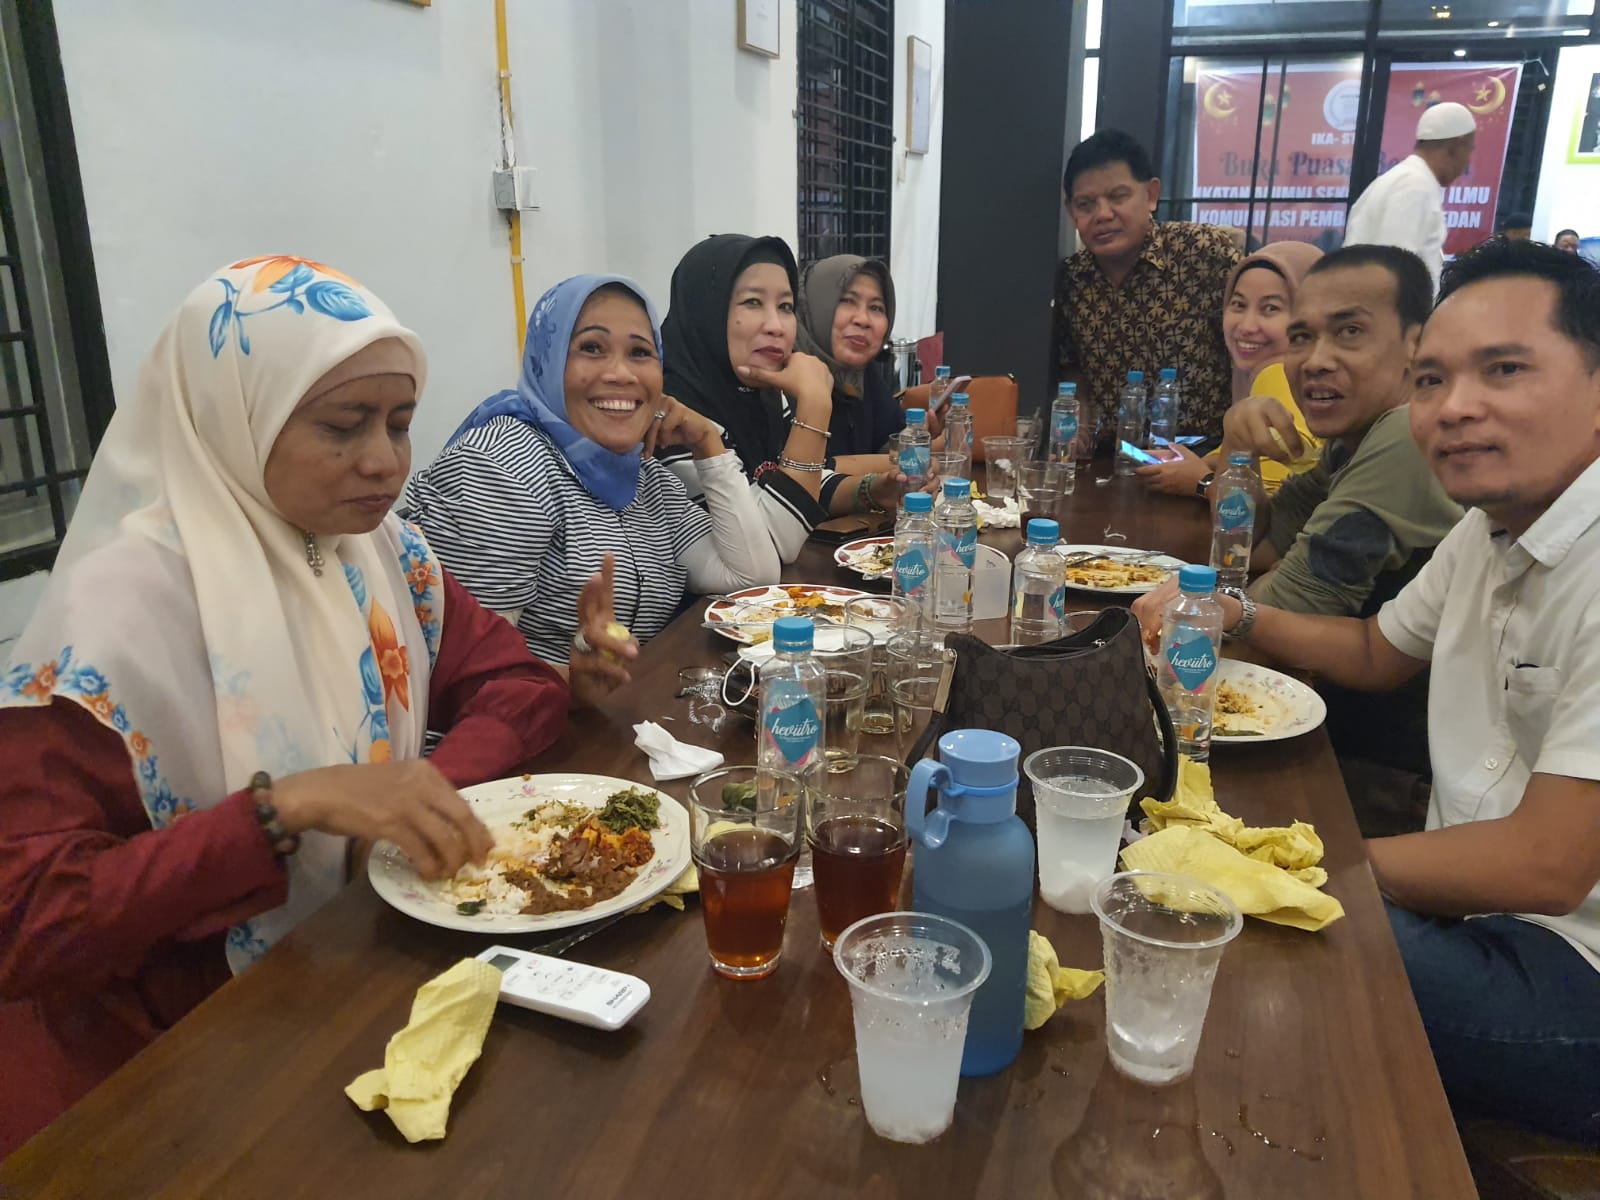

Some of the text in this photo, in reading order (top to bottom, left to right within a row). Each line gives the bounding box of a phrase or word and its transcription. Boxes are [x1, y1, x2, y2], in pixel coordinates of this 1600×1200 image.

[1448, 186, 1491, 204] ILMU
[1299, 209, 1345, 227] PEMB
[1443, 211, 1482, 228] EDAN
